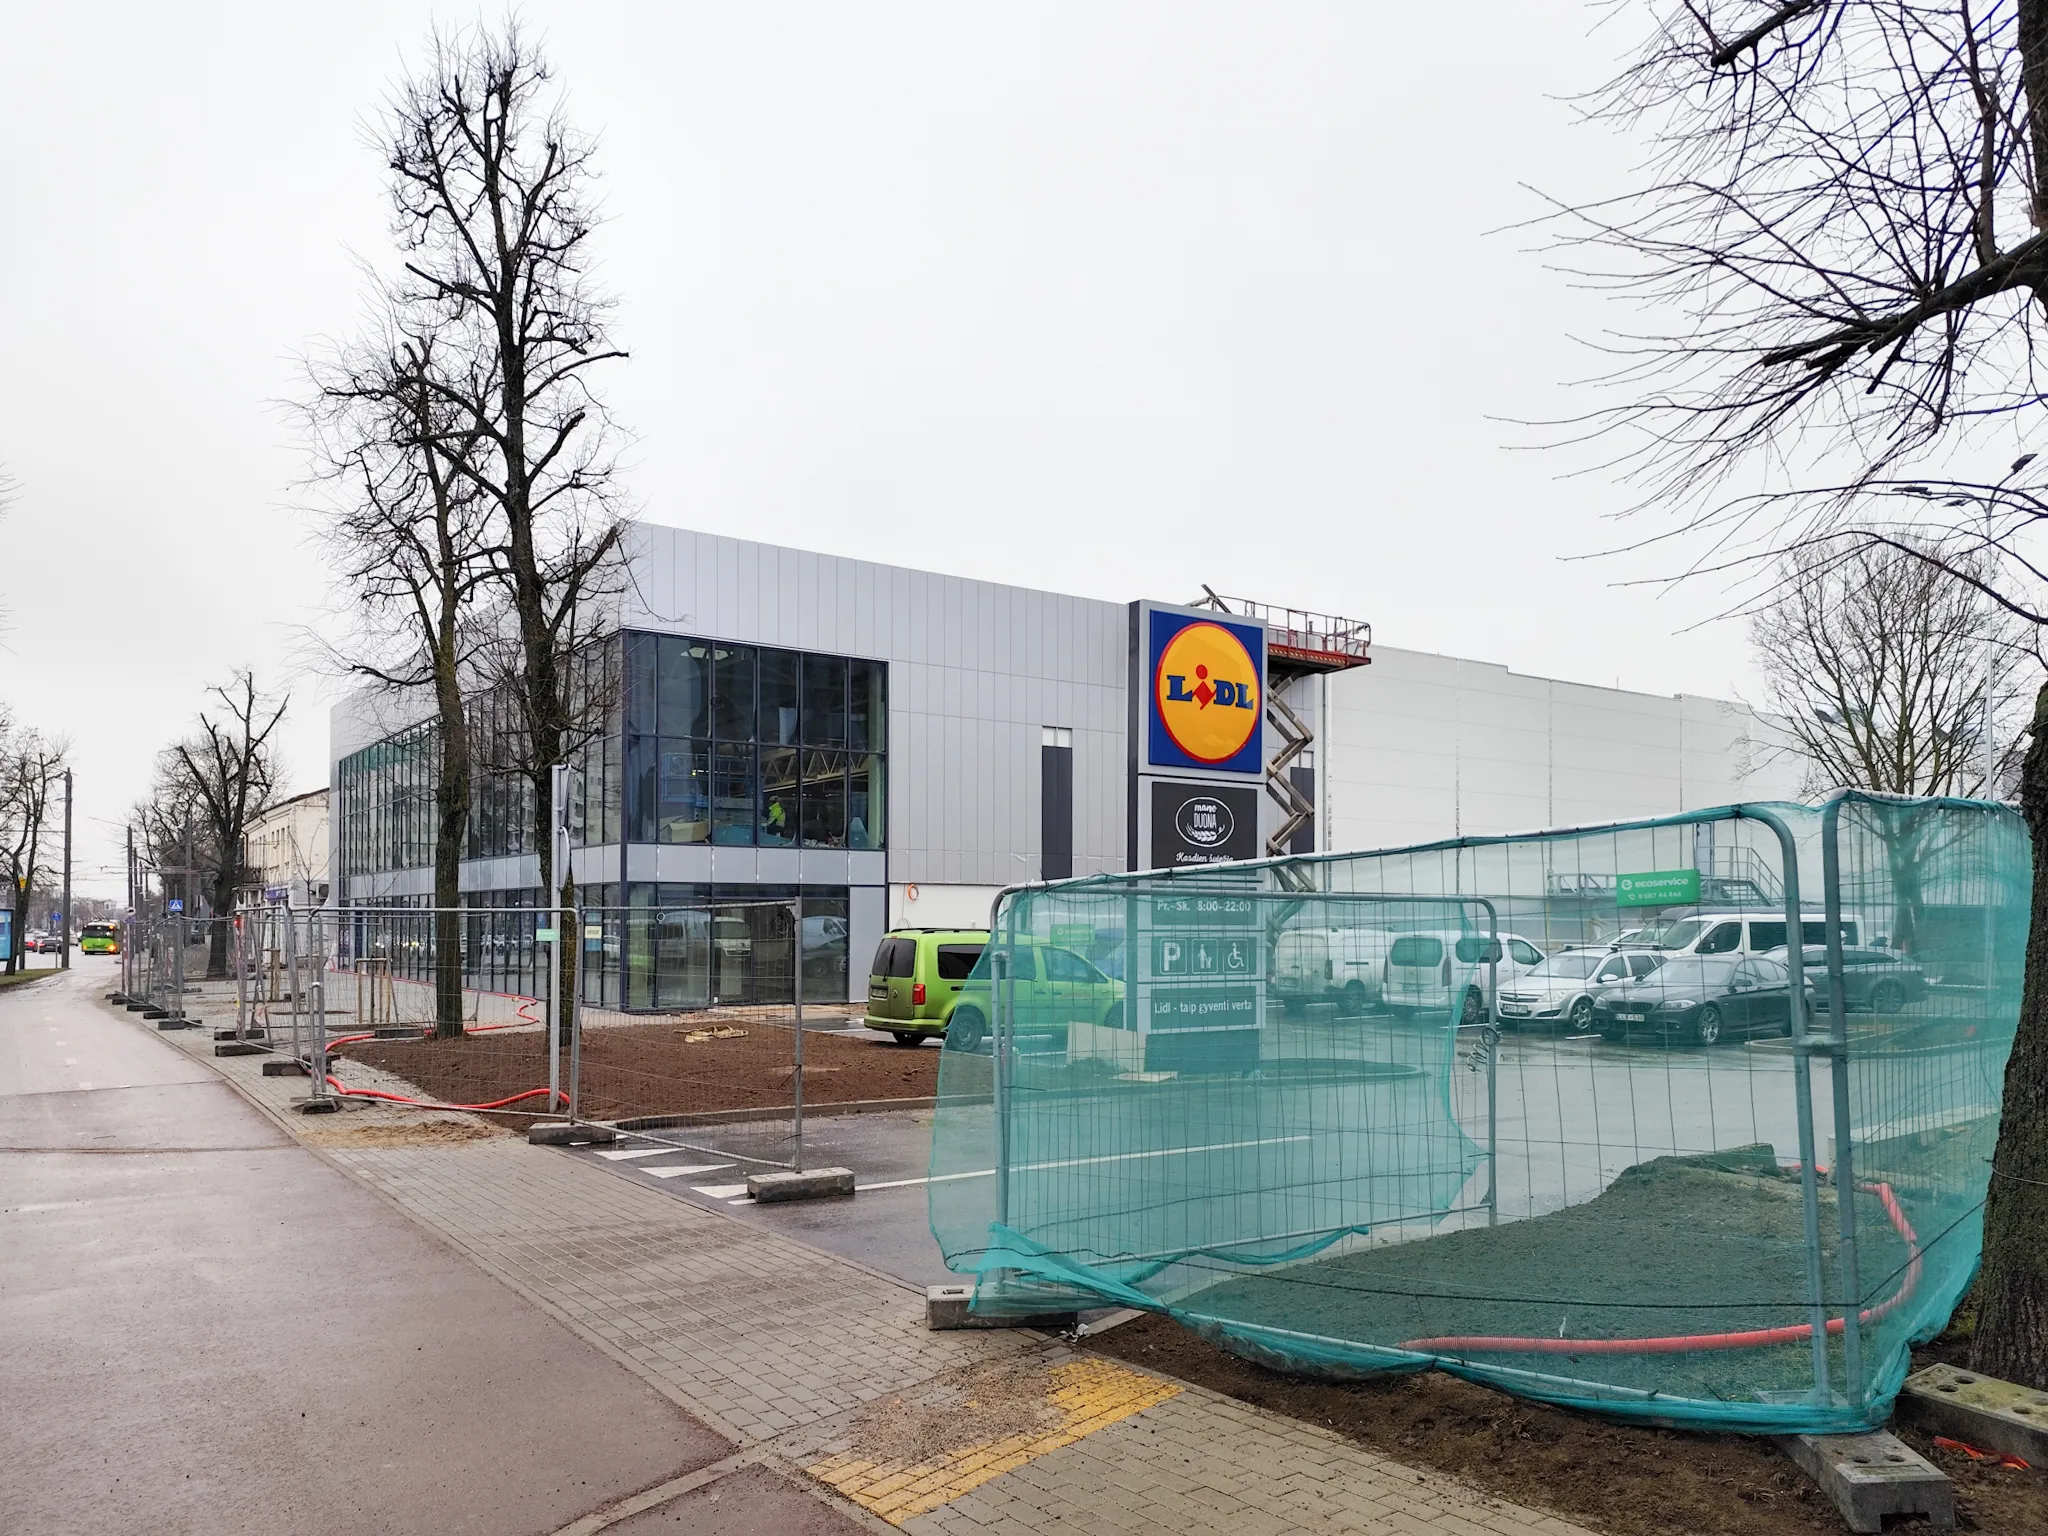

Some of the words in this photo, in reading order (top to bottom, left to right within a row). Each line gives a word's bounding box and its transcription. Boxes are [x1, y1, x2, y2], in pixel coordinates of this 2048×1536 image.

[1194, 812, 1217, 829] DUONA
[1176, 851, 1208, 863] Kasdien
[1635, 877, 1689, 888] ecoservice
[1163, 942, 1181, 972] P
[1154, 1002, 1171, 1014] Lidl
[1180, 1001, 1197, 1014] taip
[1198, 1000, 1229, 1014] gyventi
[1231, 999, 1252, 1010] verta
